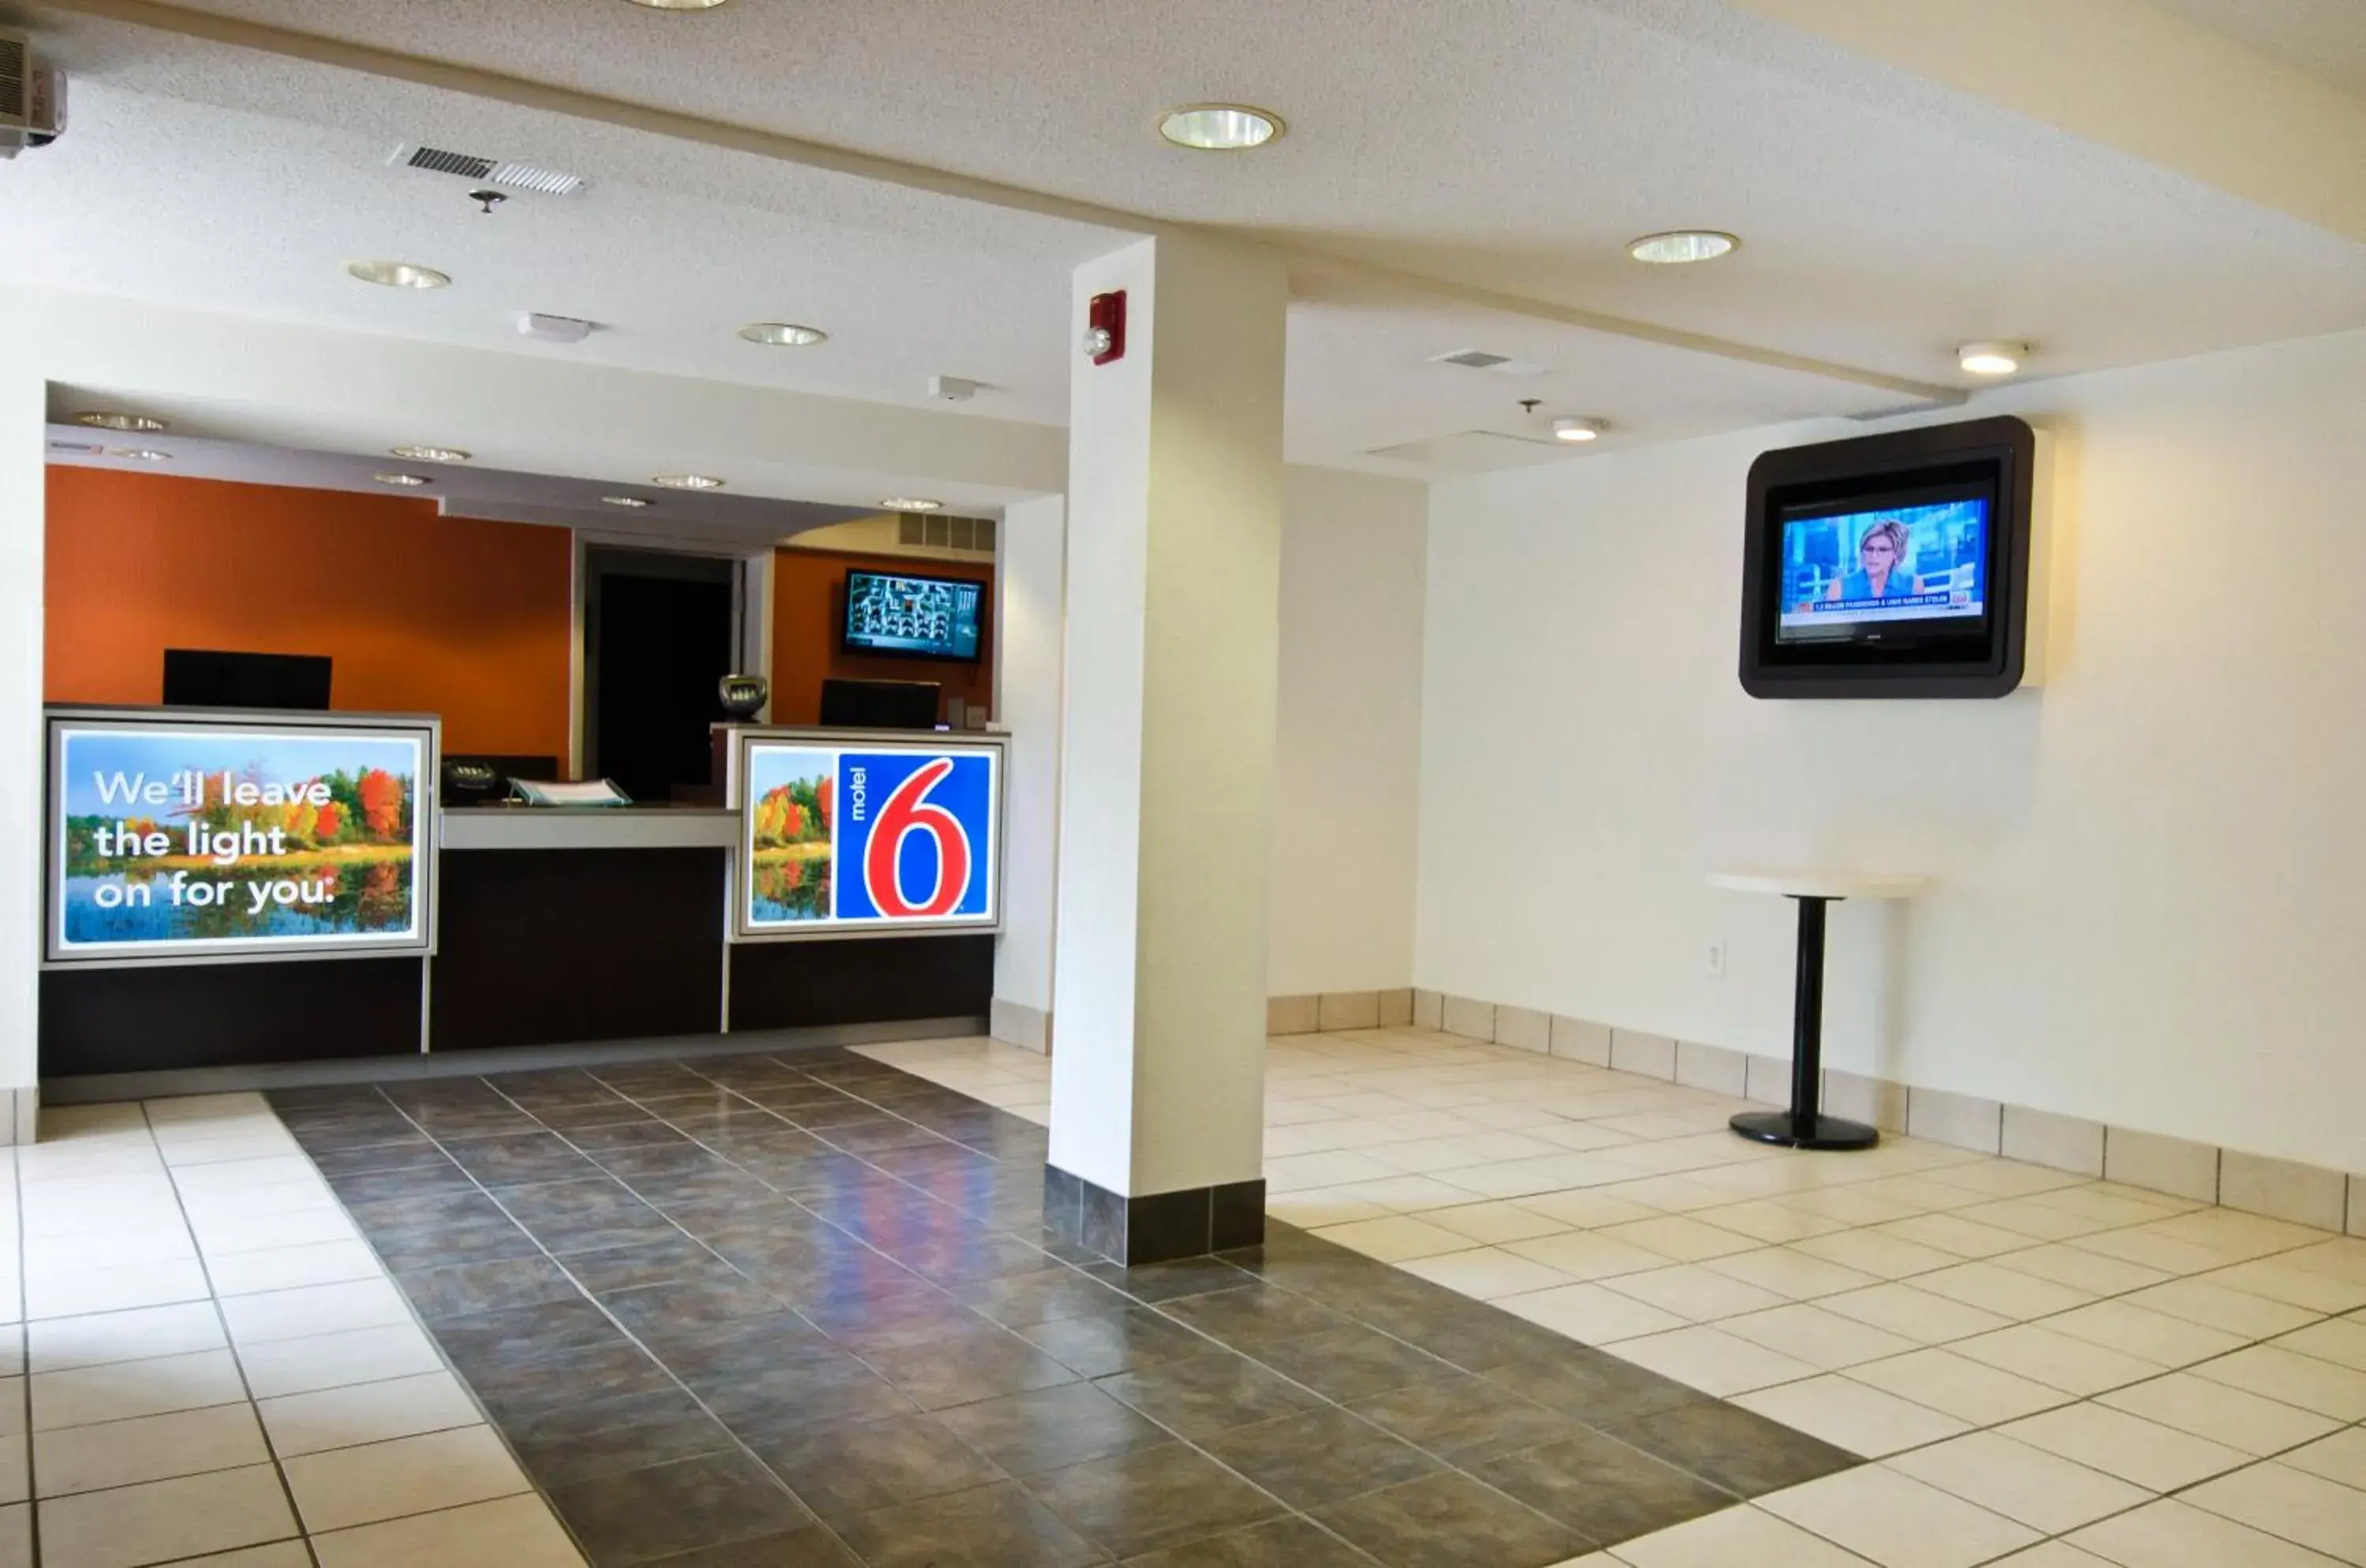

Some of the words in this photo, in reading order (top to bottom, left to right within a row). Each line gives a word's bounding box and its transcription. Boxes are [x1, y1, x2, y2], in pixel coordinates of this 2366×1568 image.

[93, 770, 204, 805] We'll
[223, 770, 332, 806] leave
[849, 767, 867, 821] motel
[92, 820, 170, 857] the
[188, 820, 287, 865] light
[863, 756, 972, 918] 6
[94, 881, 151, 908] on
[169, 870, 235, 907] for
